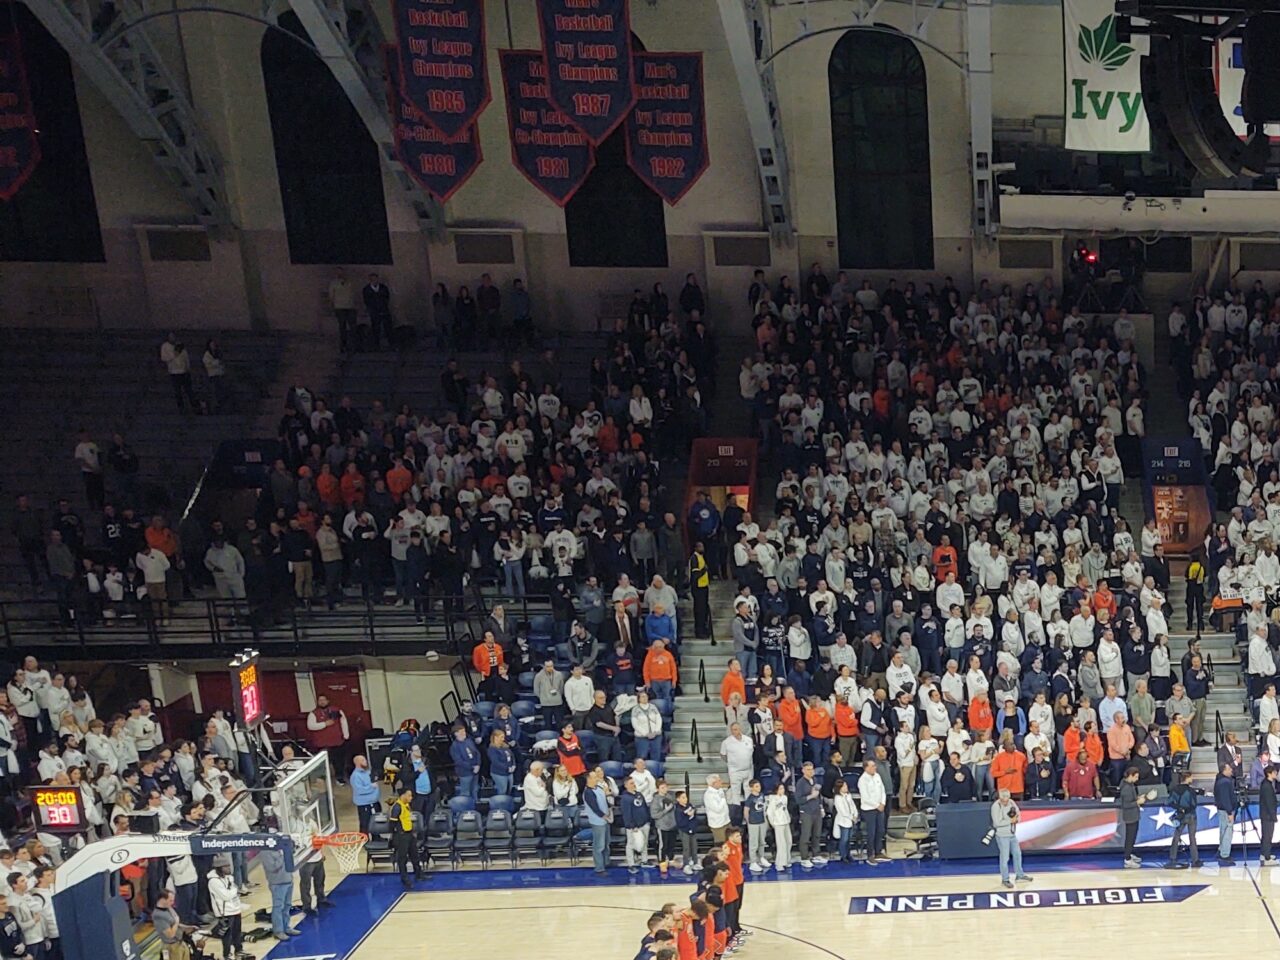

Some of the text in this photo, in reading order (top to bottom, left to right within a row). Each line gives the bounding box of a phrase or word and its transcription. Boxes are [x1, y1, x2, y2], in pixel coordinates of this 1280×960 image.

[409, 9, 468, 29] Basketball
[555, 15, 614, 32] Basketball
[409, 36, 472, 58] Ivy League
[555, 41, 617, 61] Ivy League
[414, 61, 473, 81] Champions
[559, 65, 618, 82] Champions
[426, 90, 466, 113] 1985
[573, 94, 611, 117] 1987
[1072, 79, 1142, 133] Ivy
[656, 109, 692, 126] League
[638, 131, 693, 148] Champions
[419, 155, 456, 177] 1980
[536, 157, 570, 178] 1981
[650, 157, 685, 178] 1982
[36, 791, 77, 806] 20:00
[48, 806, 71, 825] 30
[202, 838, 265, 850] Independence
[864, 886, 1165, 913] FIGHT ON PENN
